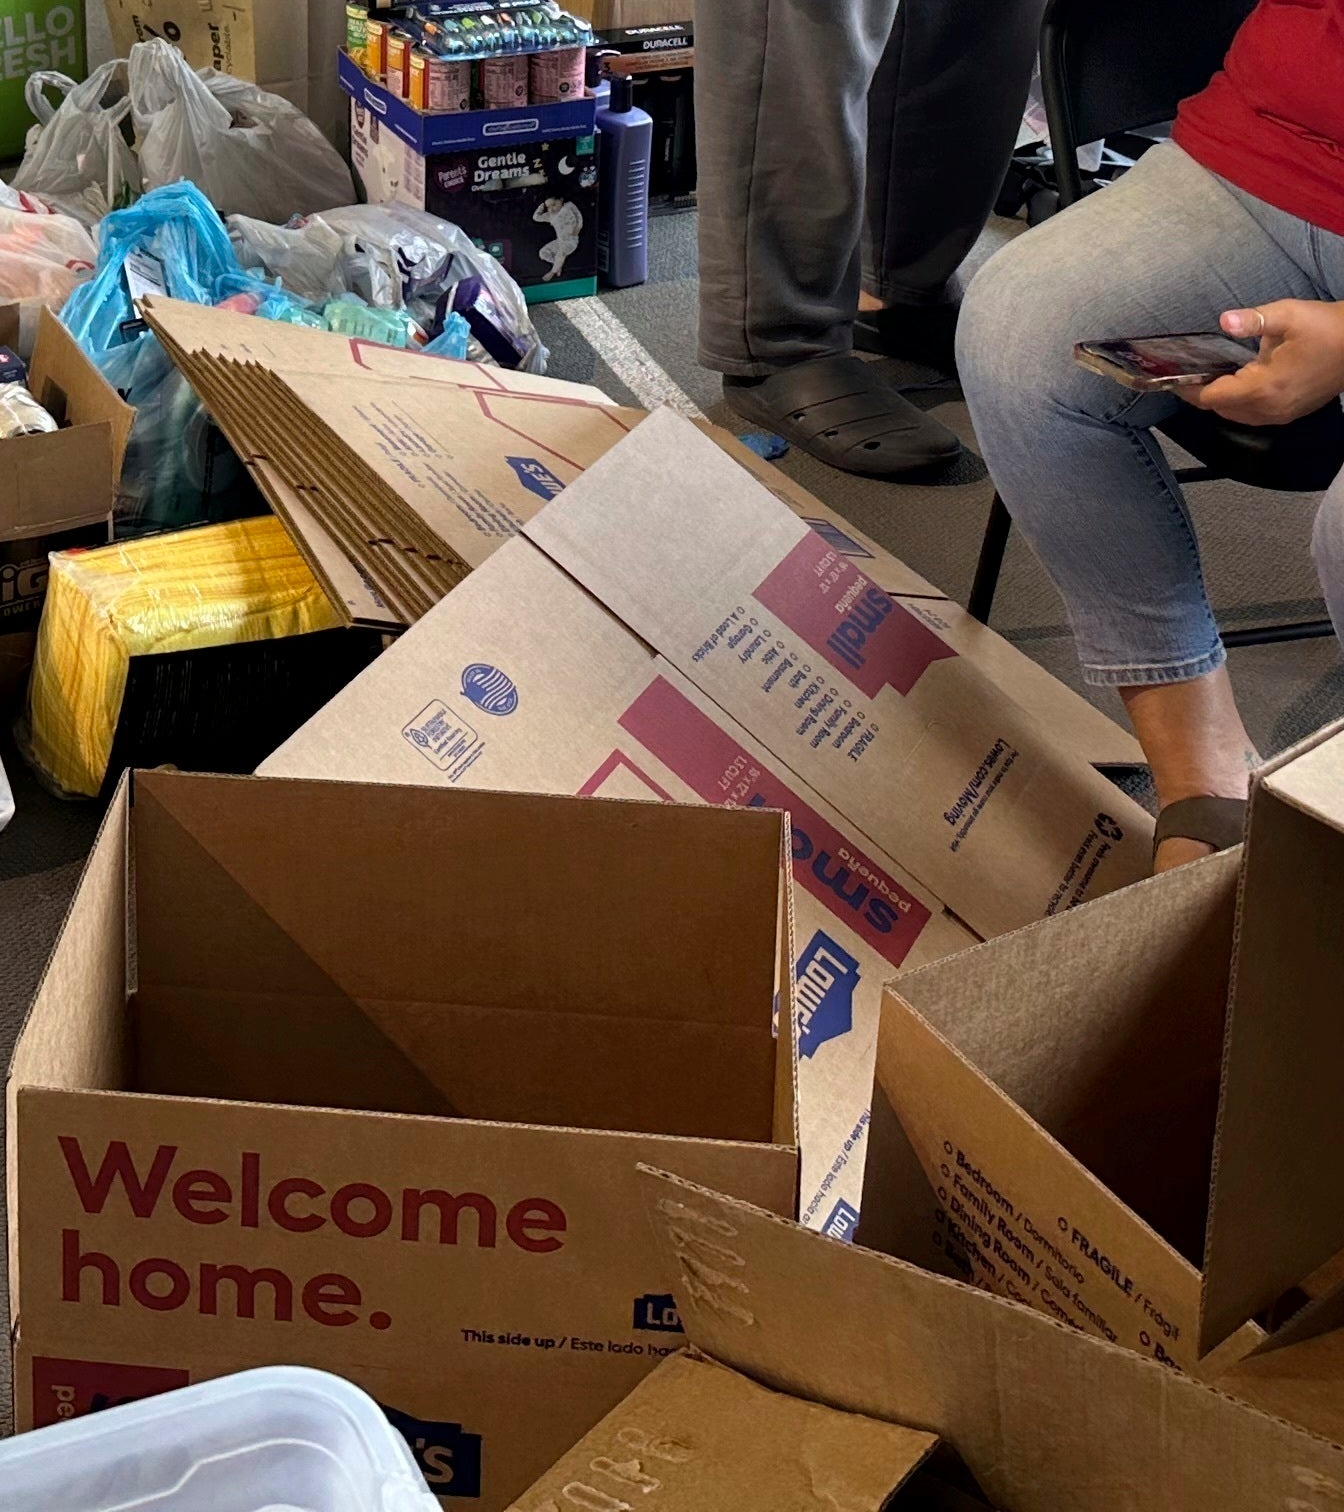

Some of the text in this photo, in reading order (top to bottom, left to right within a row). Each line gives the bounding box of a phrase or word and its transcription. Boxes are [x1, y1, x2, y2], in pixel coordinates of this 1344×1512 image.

[642, 37, 688, 50] DURACELL
[473, 164, 531, 185] Dreams
[477, 151, 527, 171] Gentle
[825, 586, 894, 671] small
[943, 737, 1010, 827] Lowes.com/Moving
[57, 1134, 568, 1255] Welcome
[953, 1174, 1035, 1267] Family Room
[955, 1149, 1016, 1217] Bedroom
[60, 1226, 393, 1331] home.
[949, 1197, 993, 1250] Dining
[993, 1242, 1031, 1287] Room
[1071, 1228, 1134, 1296] FRAGILE
[461, 1329, 643, 1355] This side up lado
